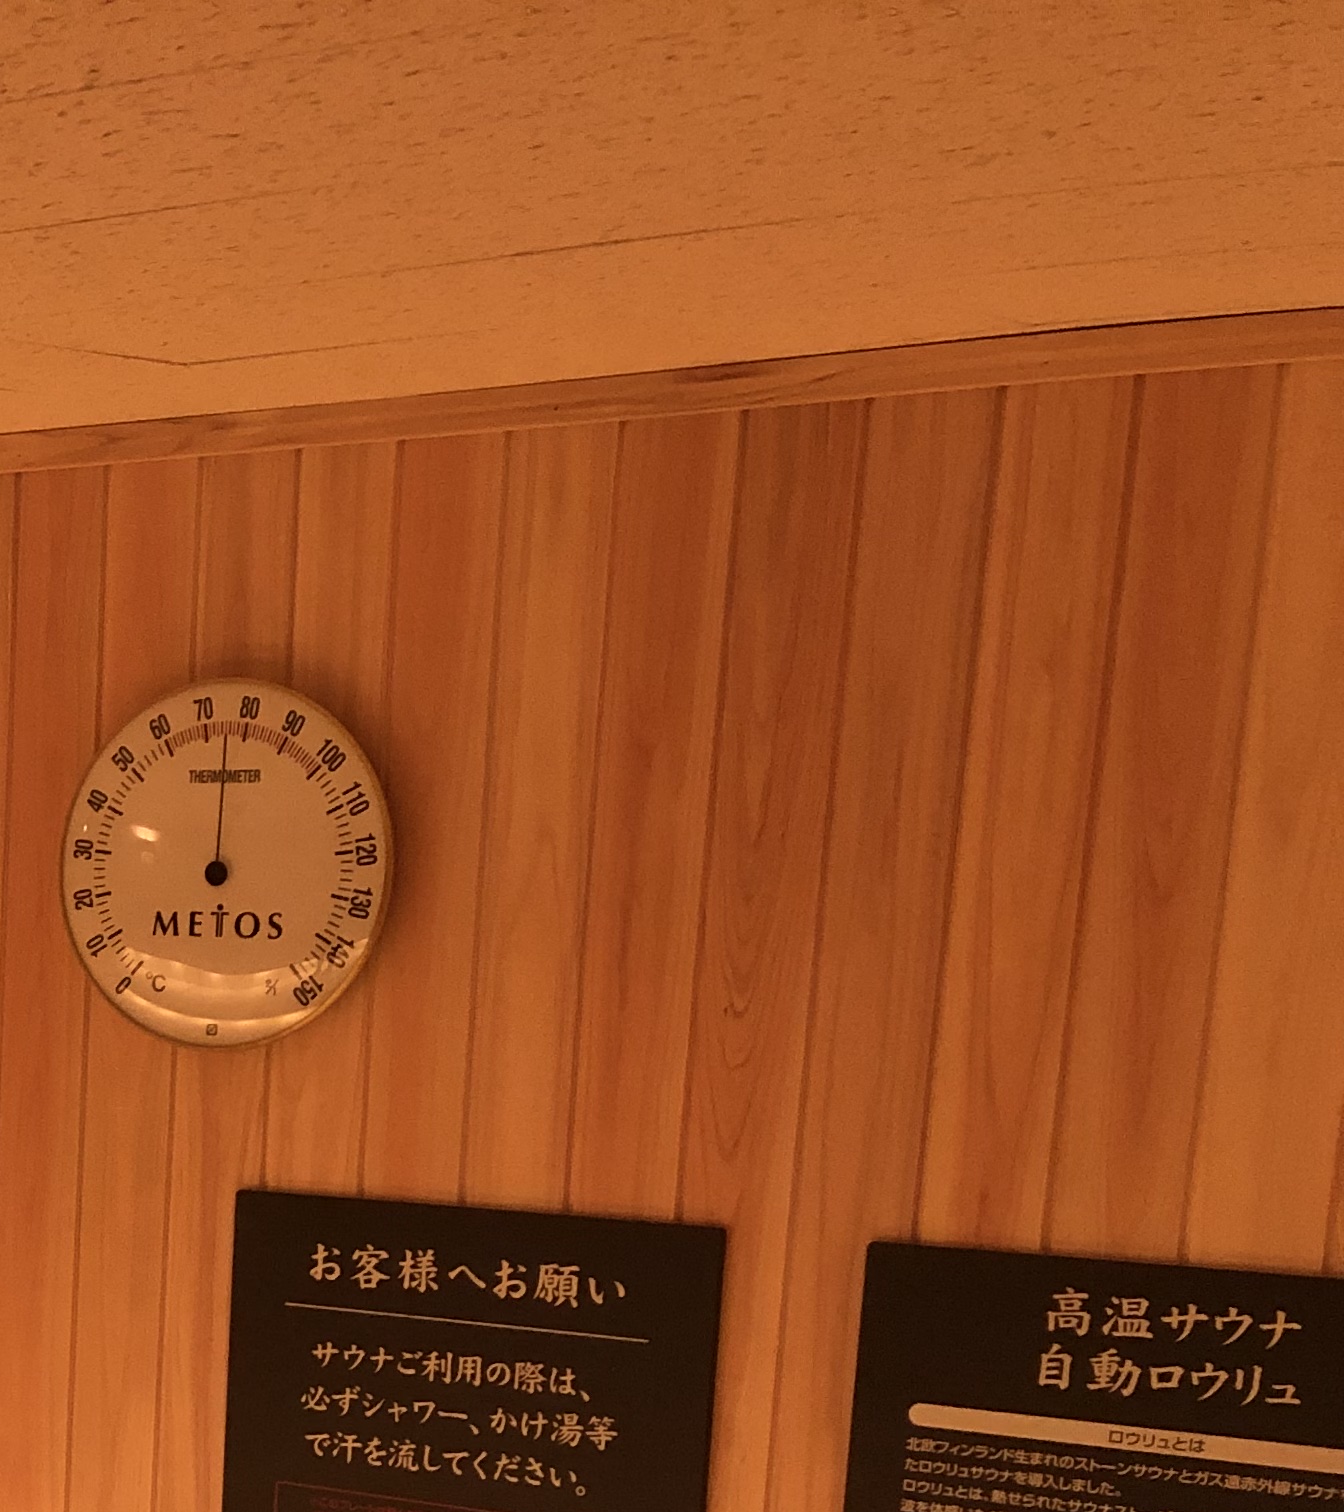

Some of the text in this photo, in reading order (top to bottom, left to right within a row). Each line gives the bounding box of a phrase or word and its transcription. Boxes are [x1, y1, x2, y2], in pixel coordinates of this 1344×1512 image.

[194, 697, 213, 721] 70
[240, 696, 261, 720] 80
[282, 710, 306, 737] 90
[149, 714, 172, 740] 60
[111, 745, 136, 773] 50
[316, 738, 347, 773] 100
[189, 769, 261, 784] THERMOMETER
[87, 788, 109, 814] 40
[342, 781, 370, 817] 110
[73, 839, 94, 860] 30
[354, 832, 378, 867] 120
[73, 888, 94, 911] 20
[348, 887, 374, 920] 130
[152, 903, 284, 940] METOS
[86, 934, 108, 958] 10
[327, 935, 355, 969] 140
[115, 977, 131, 995] 0
[293, 975, 324, 1007] 150
[309, 1243, 627, 1309] お客様へお願い
[1045, 1286, 1303, 1350] 高温サウナ
[312, 1341, 591, 1402] サウナご利用の際は、
[1037, 1343, 1302, 1407] 自動ロウリュ
[300, 1386, 619, 1452] 必ずシャワー、かけ湯等
[1108, 1429, 1206, 1455] ロウリュとは
[305, 1431, 587, 1497] で汗を流してください。
